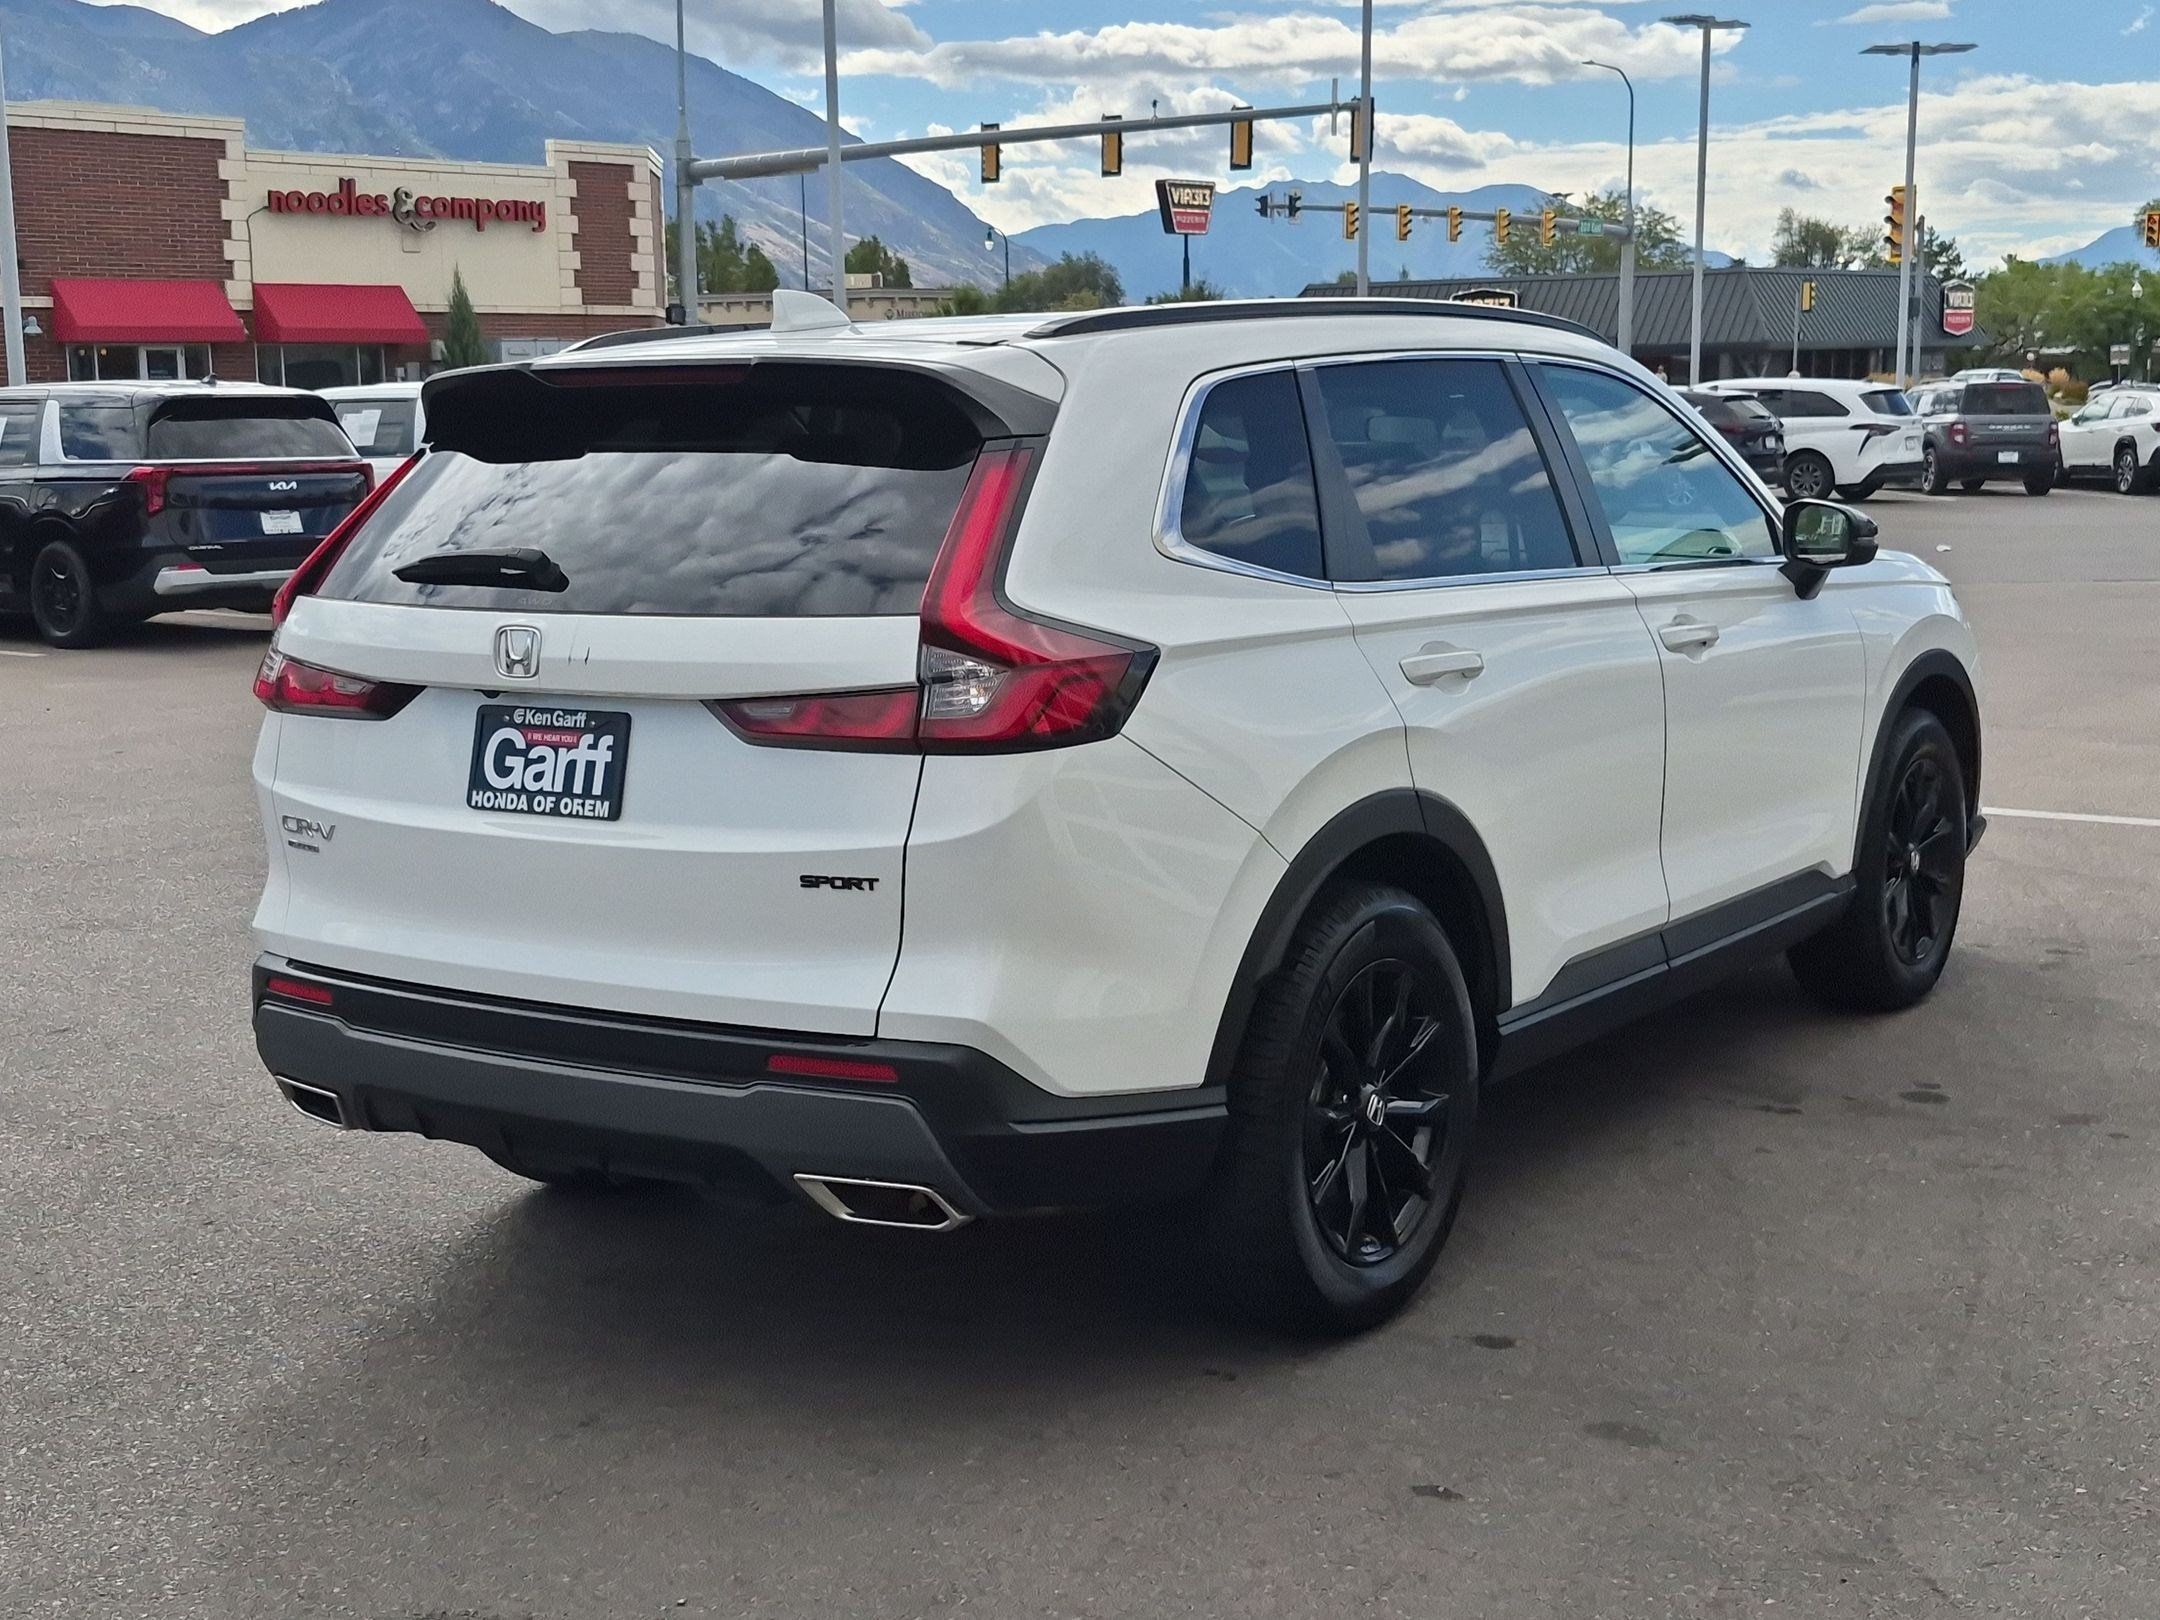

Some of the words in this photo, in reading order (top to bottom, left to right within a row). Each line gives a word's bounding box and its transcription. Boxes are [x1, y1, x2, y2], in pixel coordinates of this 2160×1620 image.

[267, 177, 390, 216] noodles
[392, 186, 437, 233] &
[414, 196, 546, 233] company
[269, 481, 298, 491] KIA
[525, 708, 551, 726] Ken
[553, 710, 587, 728] Garff
[532, 732, 543, 741] WE
[544, 733, 560, 742] HEAR
[561, 735, 574, 744] YOU
[483, 727, 614, 796] Garff
[471, 790, 529, 812] HONDA
[533, 795, 557, 813] OF
[559, 797, 610, 818] OREM
[282, 815, 336, 841] CR-V
[800, 875, 879, 891] SPORT
